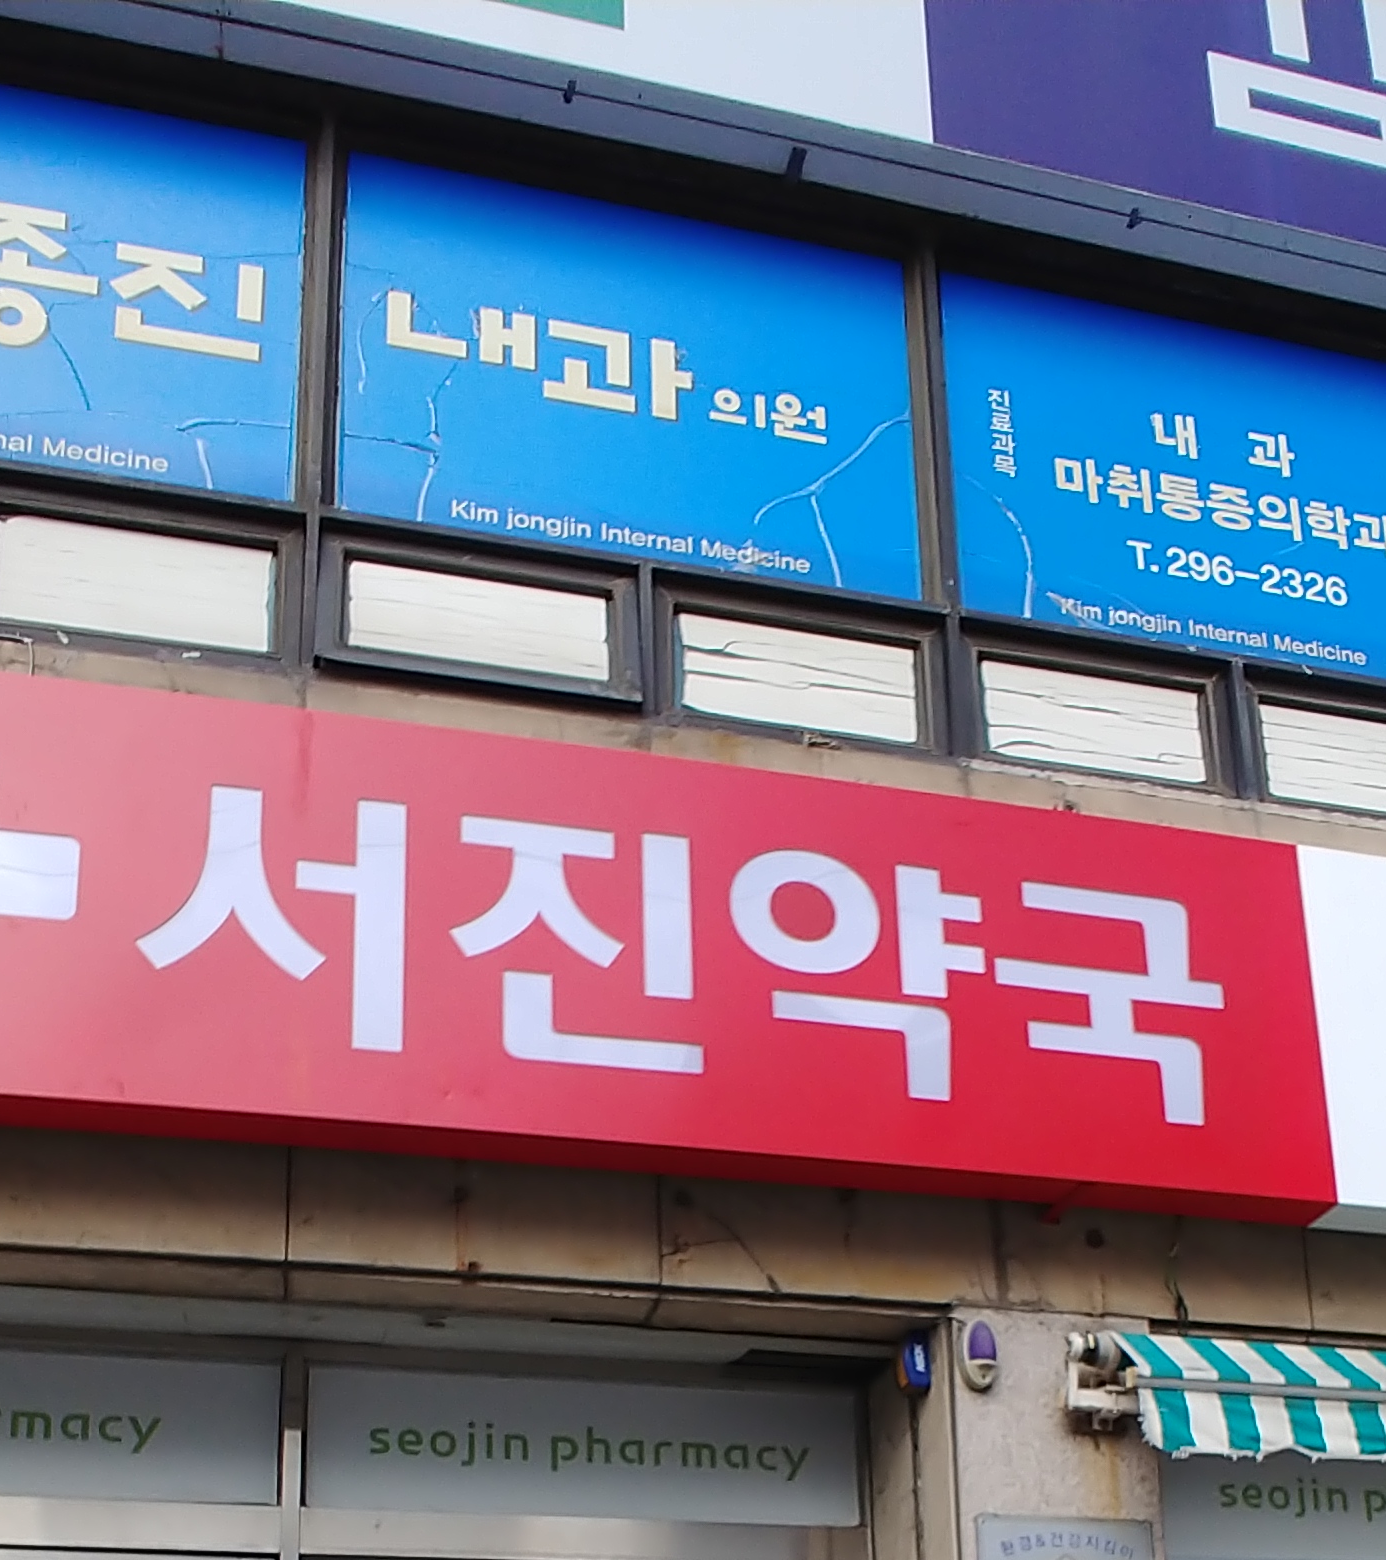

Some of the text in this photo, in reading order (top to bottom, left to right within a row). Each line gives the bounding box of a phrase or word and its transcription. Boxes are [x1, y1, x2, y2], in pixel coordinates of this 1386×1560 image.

[385, 289, 828, 444] 내과 의원
[42, 436, 169, 473] Medicine
[987, 388, 1017, 478] 진료과목
[450, 499, 811, 575] Kim jongjin Internal Medicine
[1059, 598, 1368, 667] Kim jongjin Internal Medicine
[135, 784, 1225, 1126] 서진약국
[368, 1421, 811, 1481] seojin pharmacy
[1219, 1478, 1349, 1519] seojin
